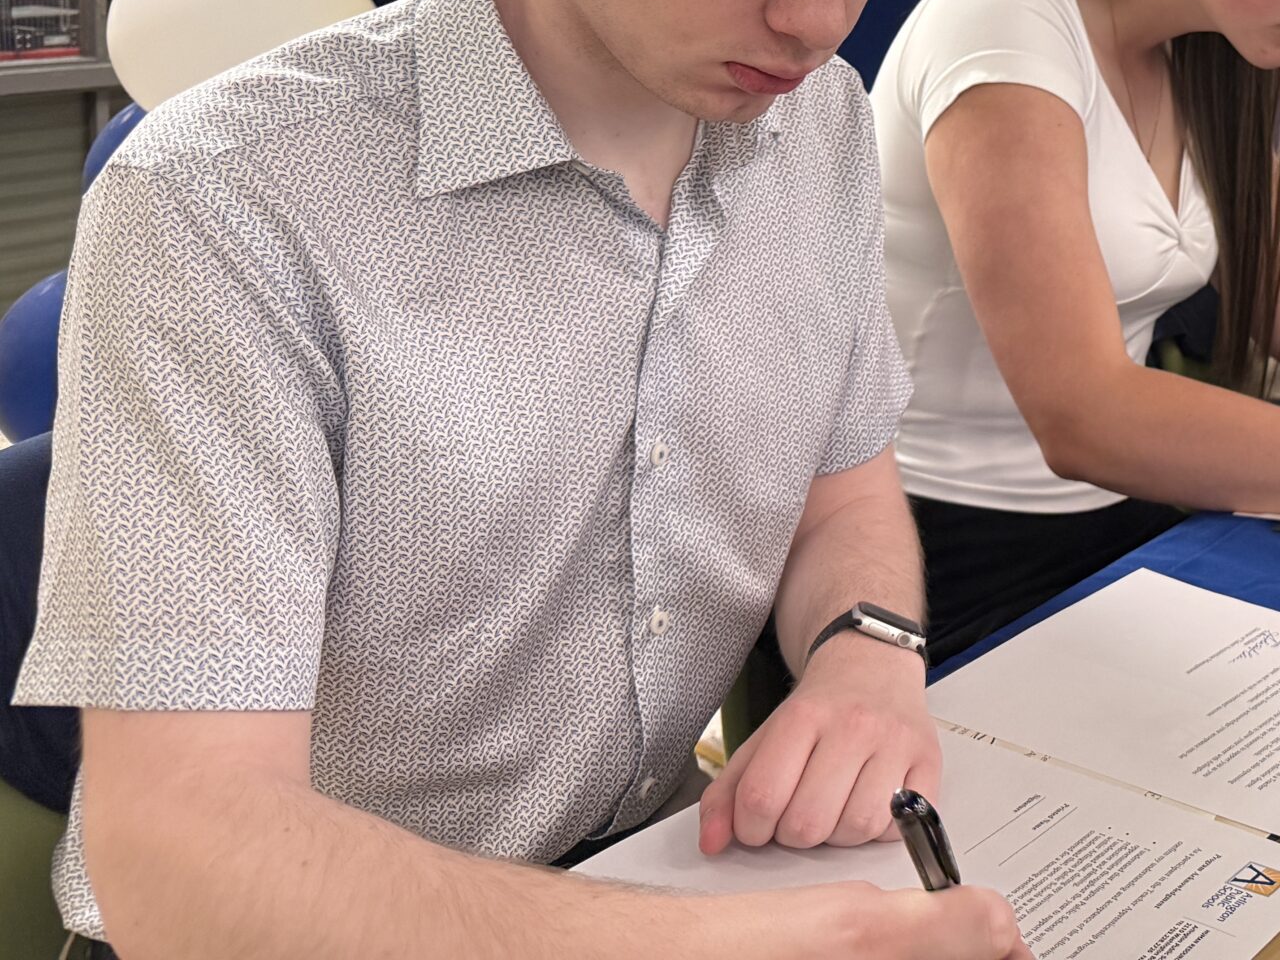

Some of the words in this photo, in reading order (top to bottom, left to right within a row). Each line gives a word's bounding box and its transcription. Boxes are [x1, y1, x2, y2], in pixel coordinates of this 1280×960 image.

[1013, 794, 1040, 814] Signature
[1047, 803, 1069, 819] Printed
[1070, 848, 1096, 868] Arlington
[1164, 855, 1190, 876] participant
[1196, 853, 1221, 871] Program
[1031, 860, 1057, 878] teaching
[1054, 867, 1074, 881] Public
[1119, 862, 1156, 891] understanding
[1010, 876, 1034, 893] position
[1017, 876, 1048, 899] completion
[1149, 881, 1161, 889] the
[1228, 864, 1276, 894] A
[1033, 881, 1057, 897] Schools
[1069, 892, 1082, 900] the
[1082, 880, 1109, 901] Arlington
[1110, 890, 1123, 900] and
[1130, 888, 1154, 906] Teacher
[1154, 871, 1198, 908] Acknowledgment
[1201, 885, 1233, 908] Schools
[1216, 888, 1243, 907] Public
[1025, 893, 1053, 914] university
[1058, 899, 1072, 910] year
[1065, 900, 1086, 915] Public
[1083, 899, 1112, 923] acceptance
[1217, 892, 1252, 921] Arlington
[1030, 914, 1053, 931] support
[1043, 914, 1068, 932] Schools
[1066, 928, 1079, 936] the
[1091, 906, 1132, 939] Apprenticeship
[1154, 932, 1183, 952] Washington
[1177, 924, 1198, 943] Arlington
